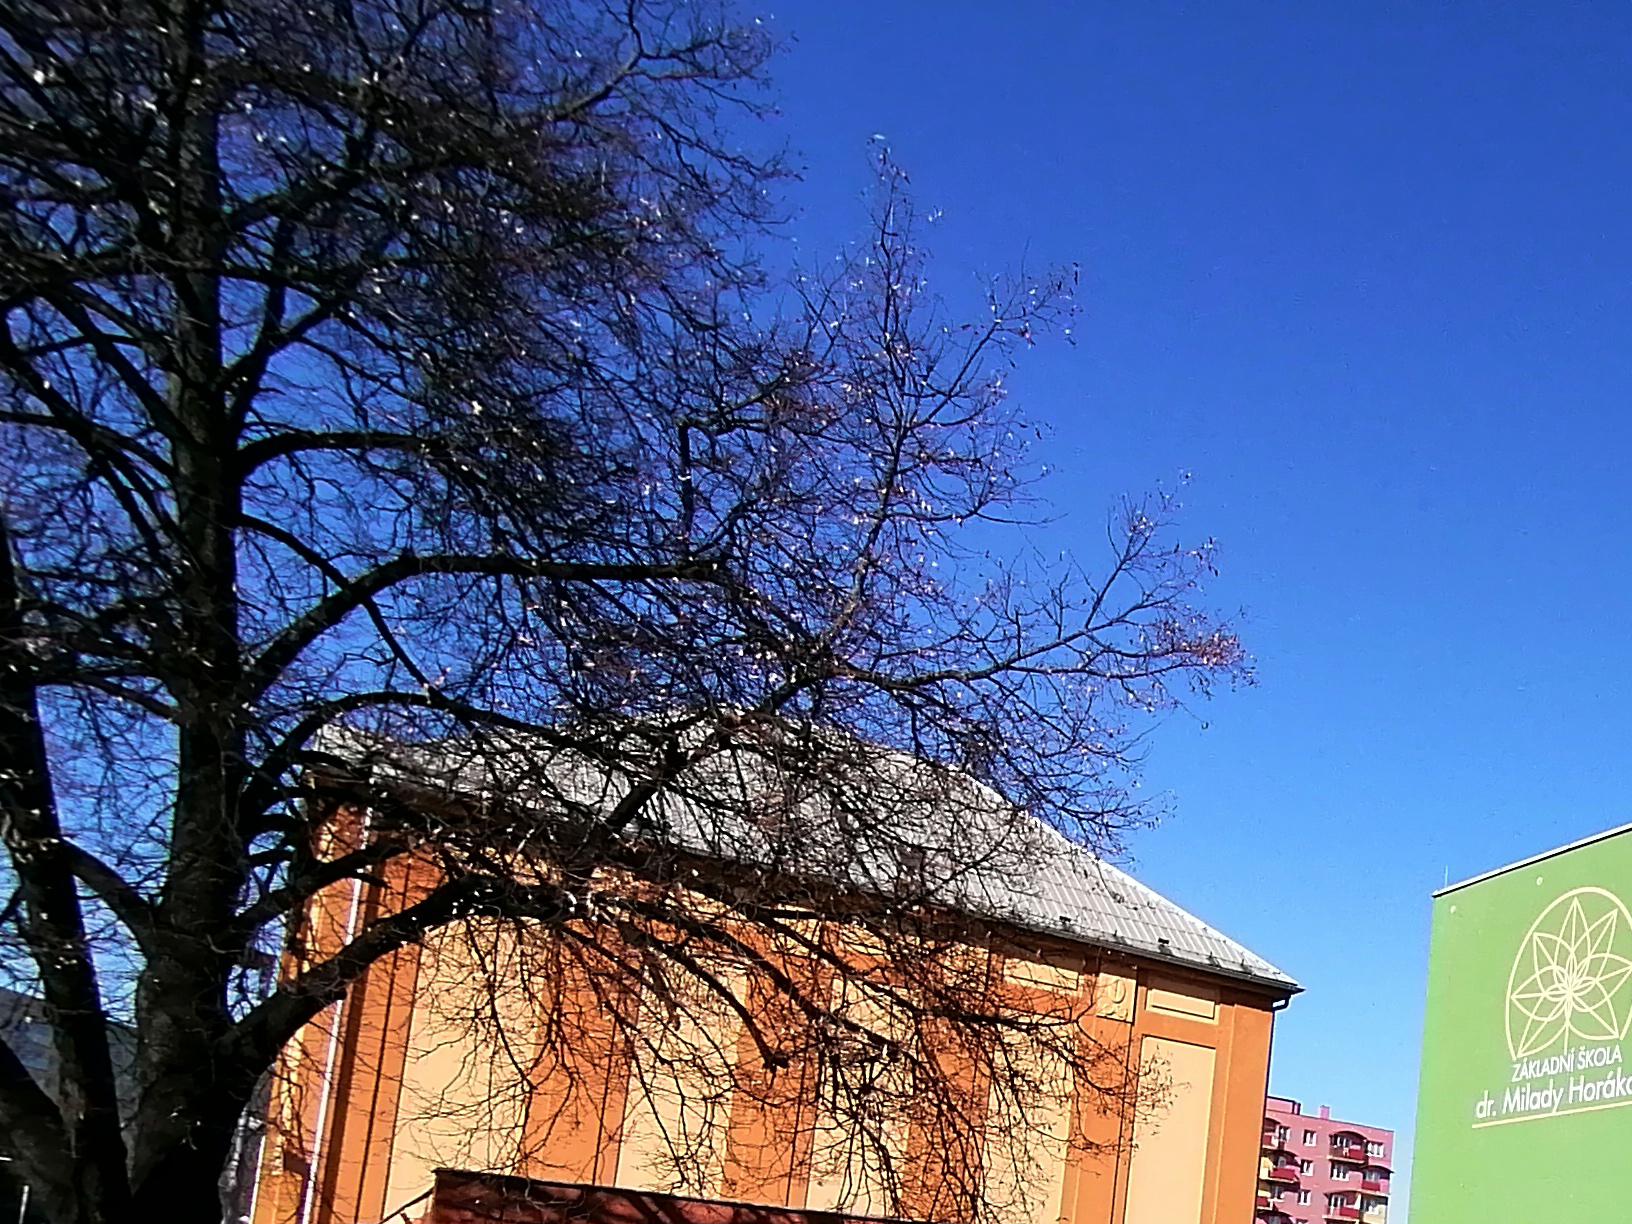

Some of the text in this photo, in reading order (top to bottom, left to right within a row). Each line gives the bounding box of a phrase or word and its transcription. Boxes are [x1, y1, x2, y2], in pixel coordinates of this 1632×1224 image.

[1511, 1044, 1623, 1082] ZÁKLADNÍ ŠKOLA
[1475, 1090, 1497, 1118] dr.
[1502, 1079, 1564, 1114] Milady
